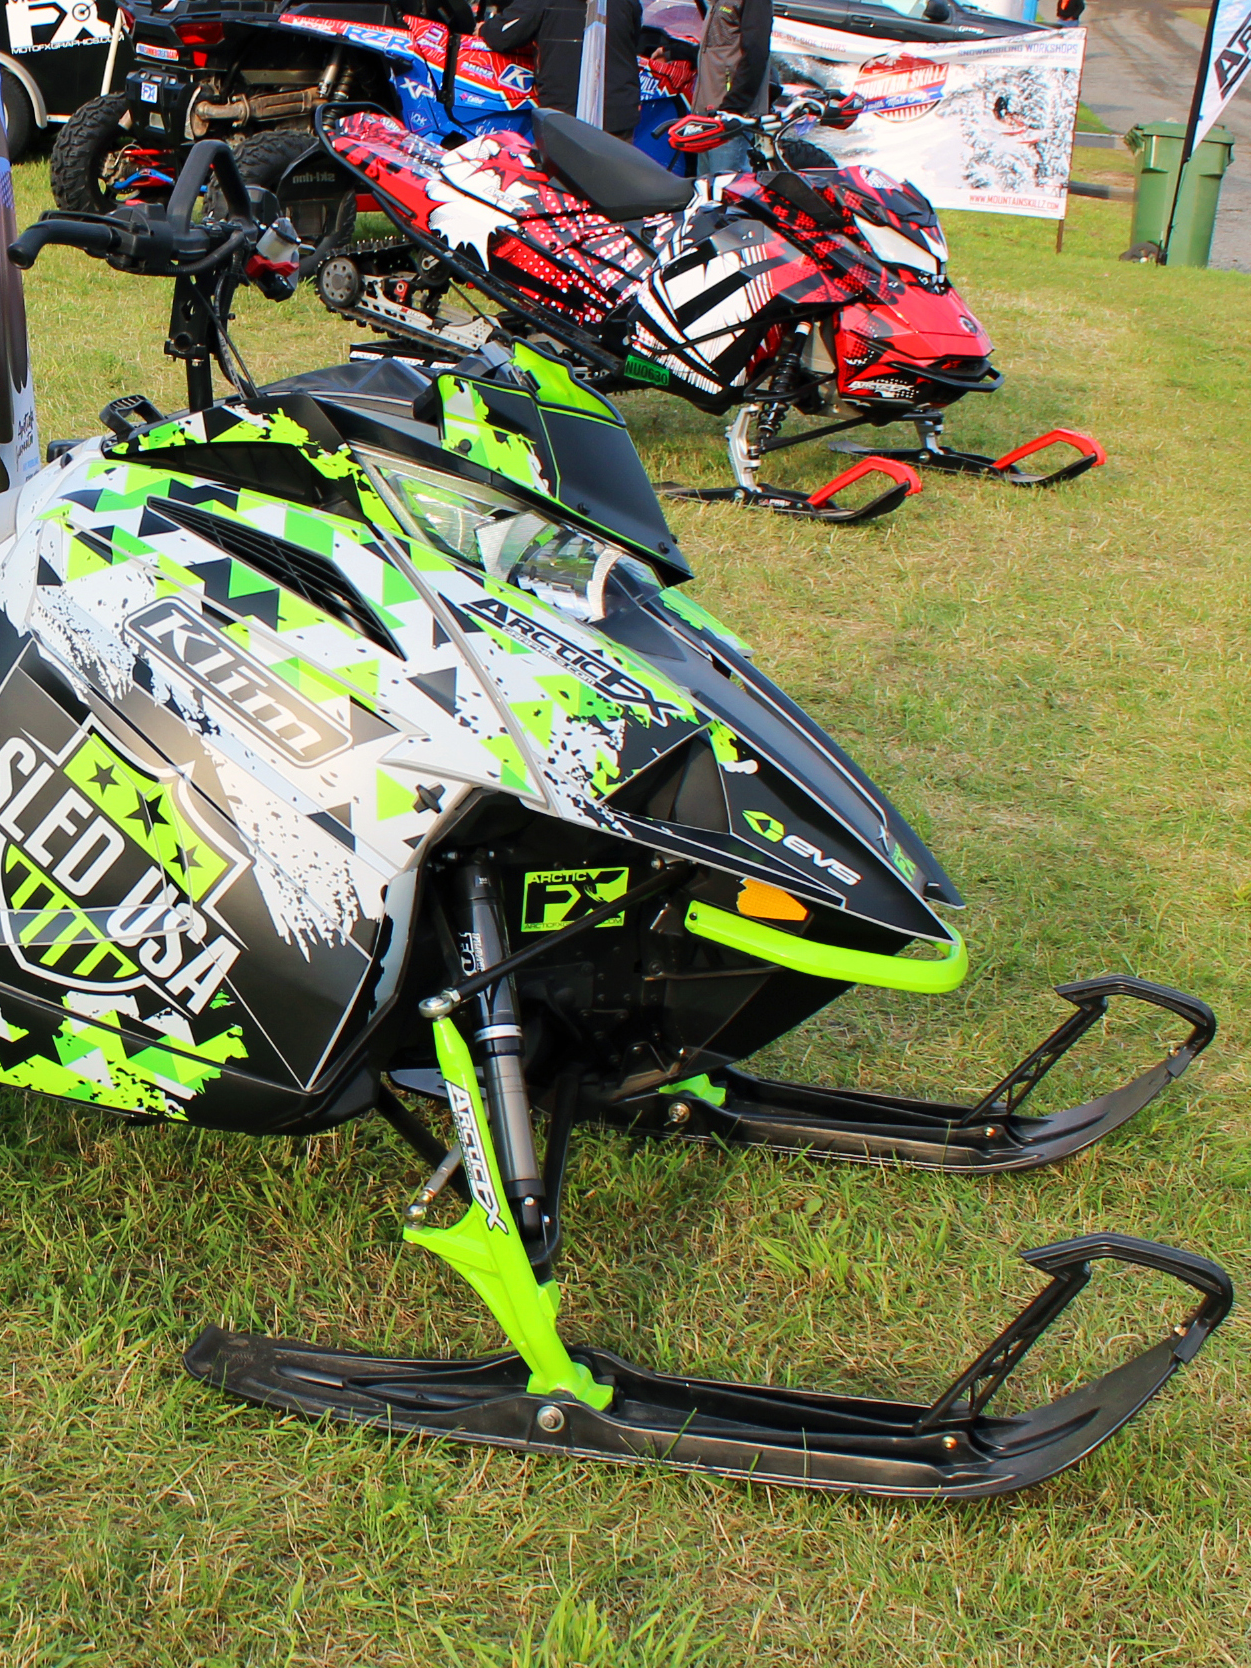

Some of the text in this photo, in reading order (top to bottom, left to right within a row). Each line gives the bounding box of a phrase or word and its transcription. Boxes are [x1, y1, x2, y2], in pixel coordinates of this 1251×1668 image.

[344, 26, 413, 51] RZR
[820, 42, 847, 53] TOURS
[957, 44, 1022, 57] SNOWMOBILING
[1025, 43, 1079, 54] WORKSHOPS
[853, 70, 908, 100] MOUNTAIN
[909, 63, 949, 89] SKILLZ
[531, 872, 588, 884] ARCTIC
[525, 869, 626, 924] FX
[107, 866, 240, 1015] USA
